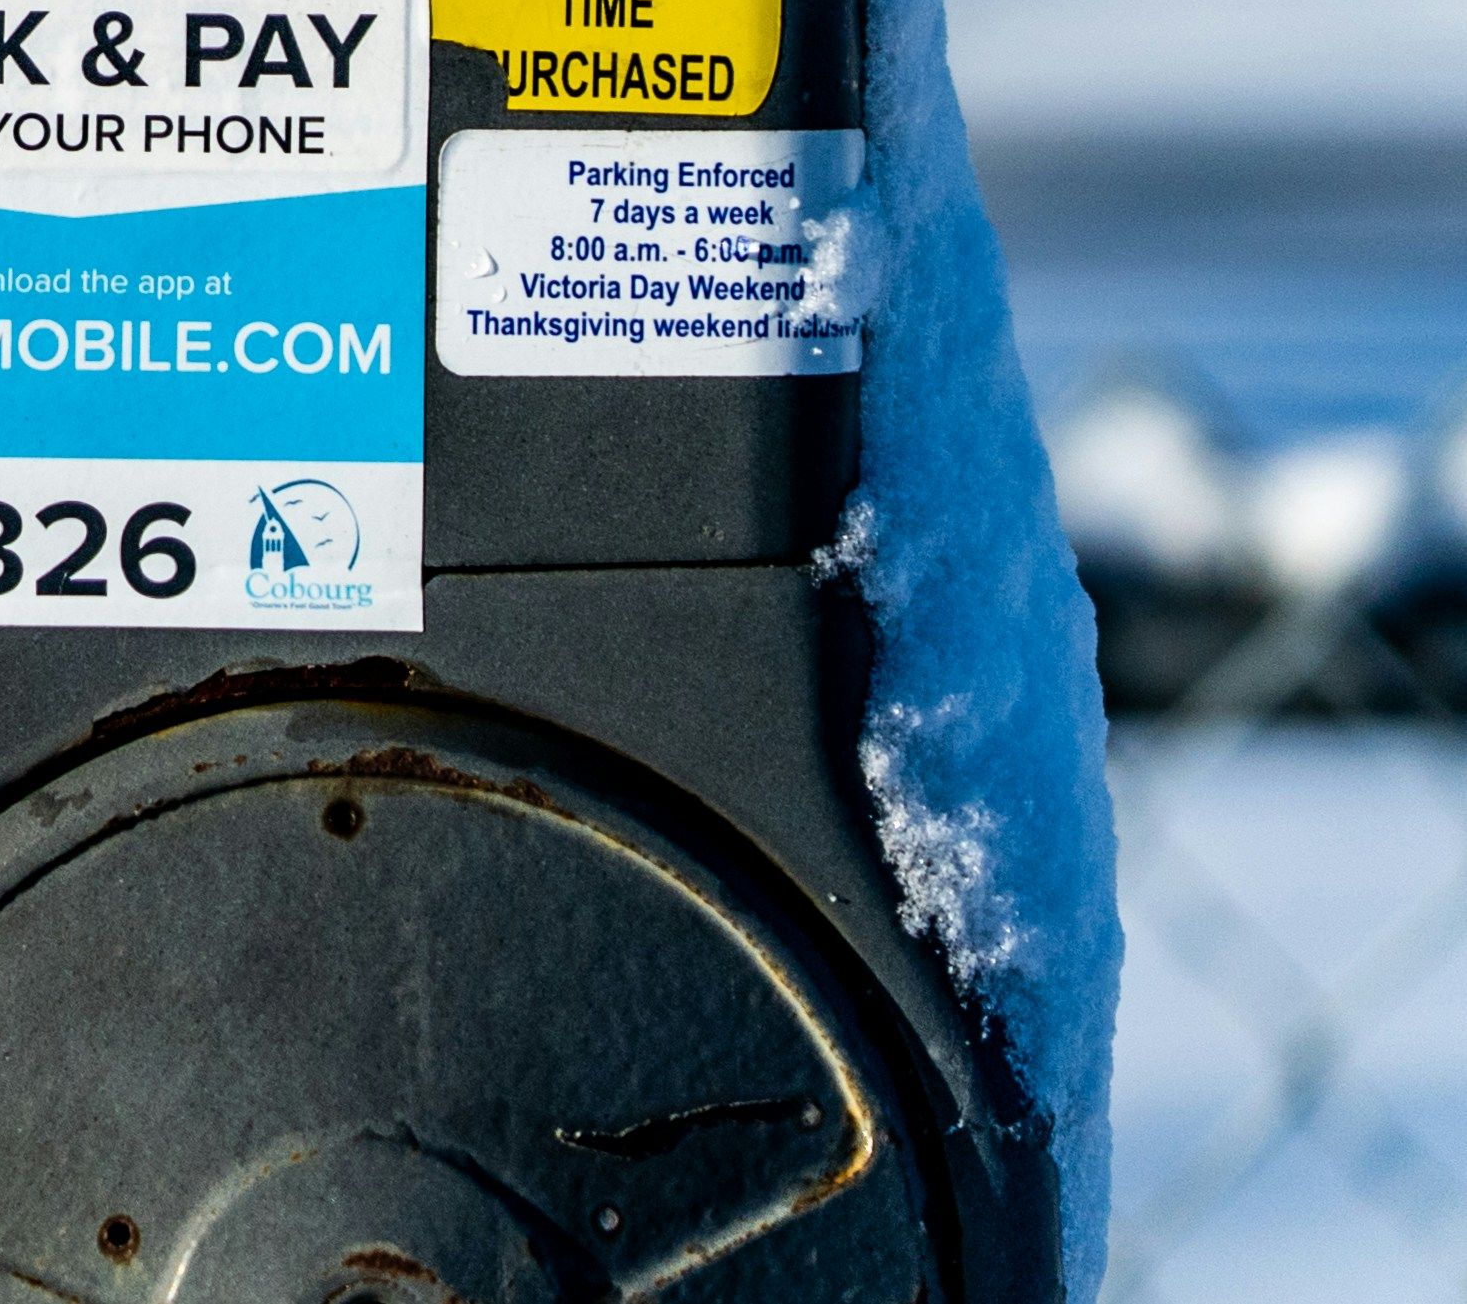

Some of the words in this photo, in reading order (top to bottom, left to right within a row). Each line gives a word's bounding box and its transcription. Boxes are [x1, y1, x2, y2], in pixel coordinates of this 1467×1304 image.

[82, 12, 148, 86] &
[185, 14, 377, 88] PAY
[496, 50, 734, 102] URCHASED
[145, 115, 324, 154] PHONE
[570, 161, 668, 193] Parking
[679, 162, 796, 188] Enforced
[591, 199, 604, 223] 7
[614, 199, 675, 230] days
[685, 206, 698, 224] a
[708, 200, 774, 225] week
[551, 236, 604, 261] 8:00
[614, 243, 667, 262] a.m.
[758, 244, 809, 269] p.m.
[81, 269, 128, 293] the
[139, 275, 194, 300] app
[205, 272, 231, 295] at
[521, 273, 620, 299] Victoria
[631, 275, 679, 306] Day
[689, 275, 805, 302] Weekend
[467, 310, 644, 343] Thanksgiving
[654, 313, 769, 338] weekend
[245, 572, 373, 606] Cobourg
